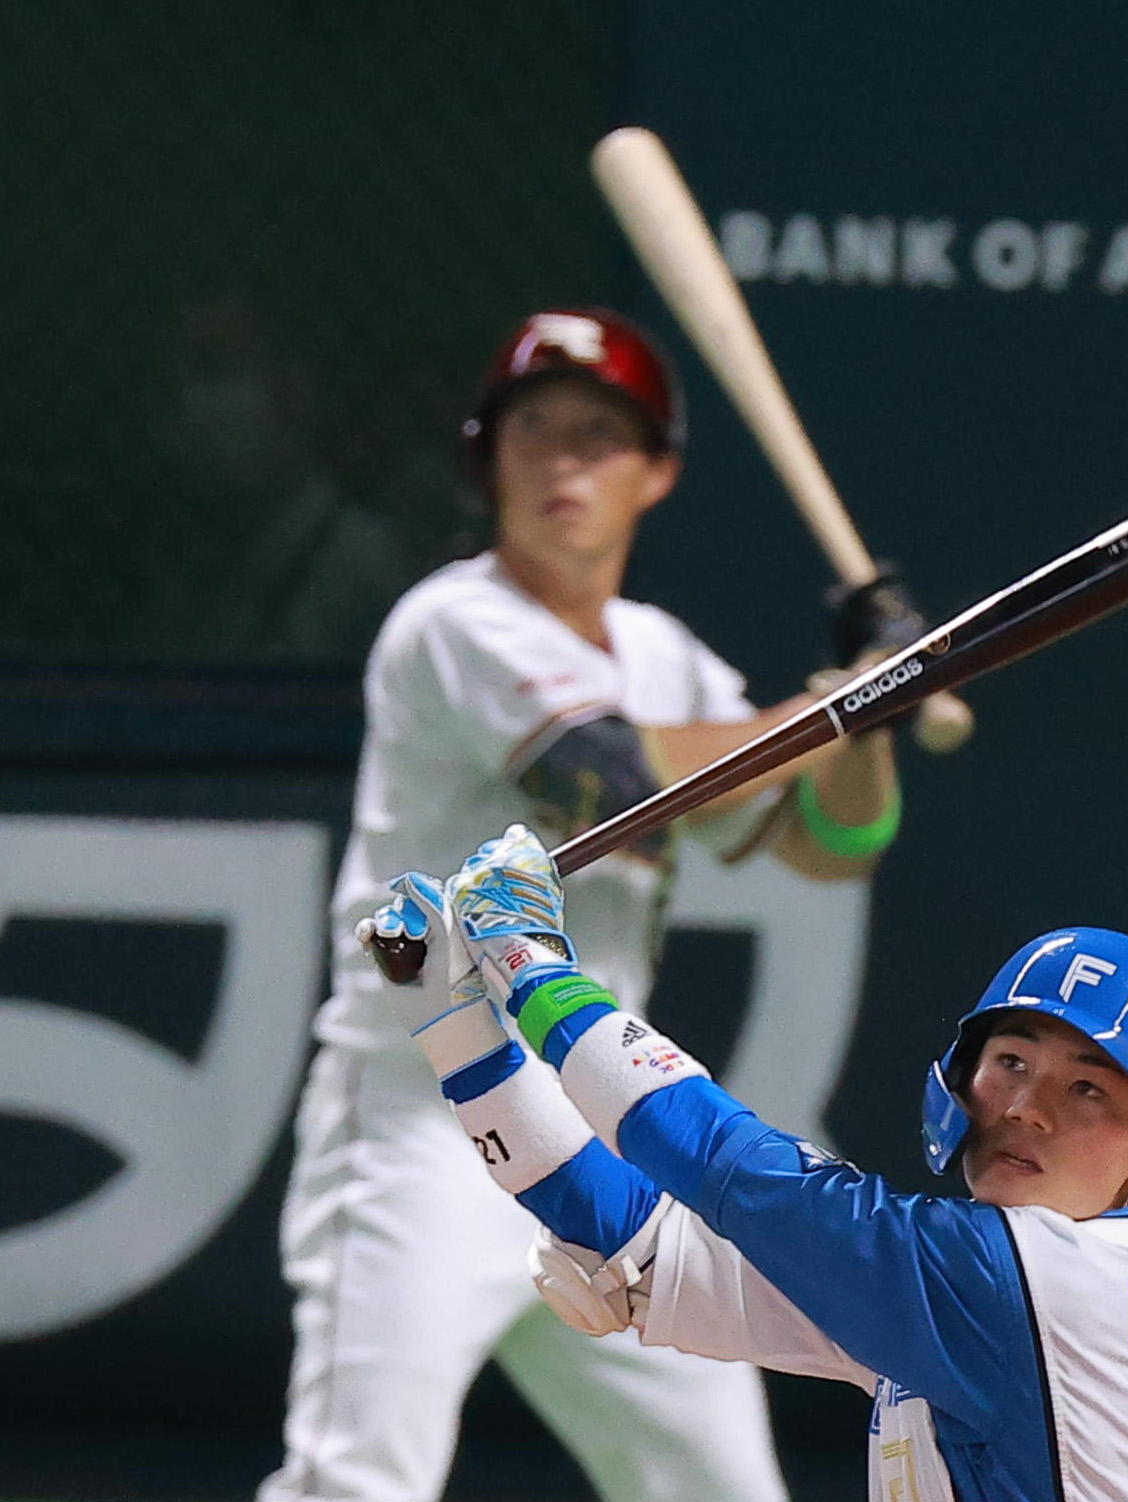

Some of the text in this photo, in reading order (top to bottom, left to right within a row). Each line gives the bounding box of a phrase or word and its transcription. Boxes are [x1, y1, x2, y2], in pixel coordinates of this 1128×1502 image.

[720, 210, 958, 290] BANK
[972, 218, 1091, 293] OF
[842, 656, 924, 715] adidas
[1058, 953, 1119, 1004] F
[473, 1128, 511, 1166] 21
